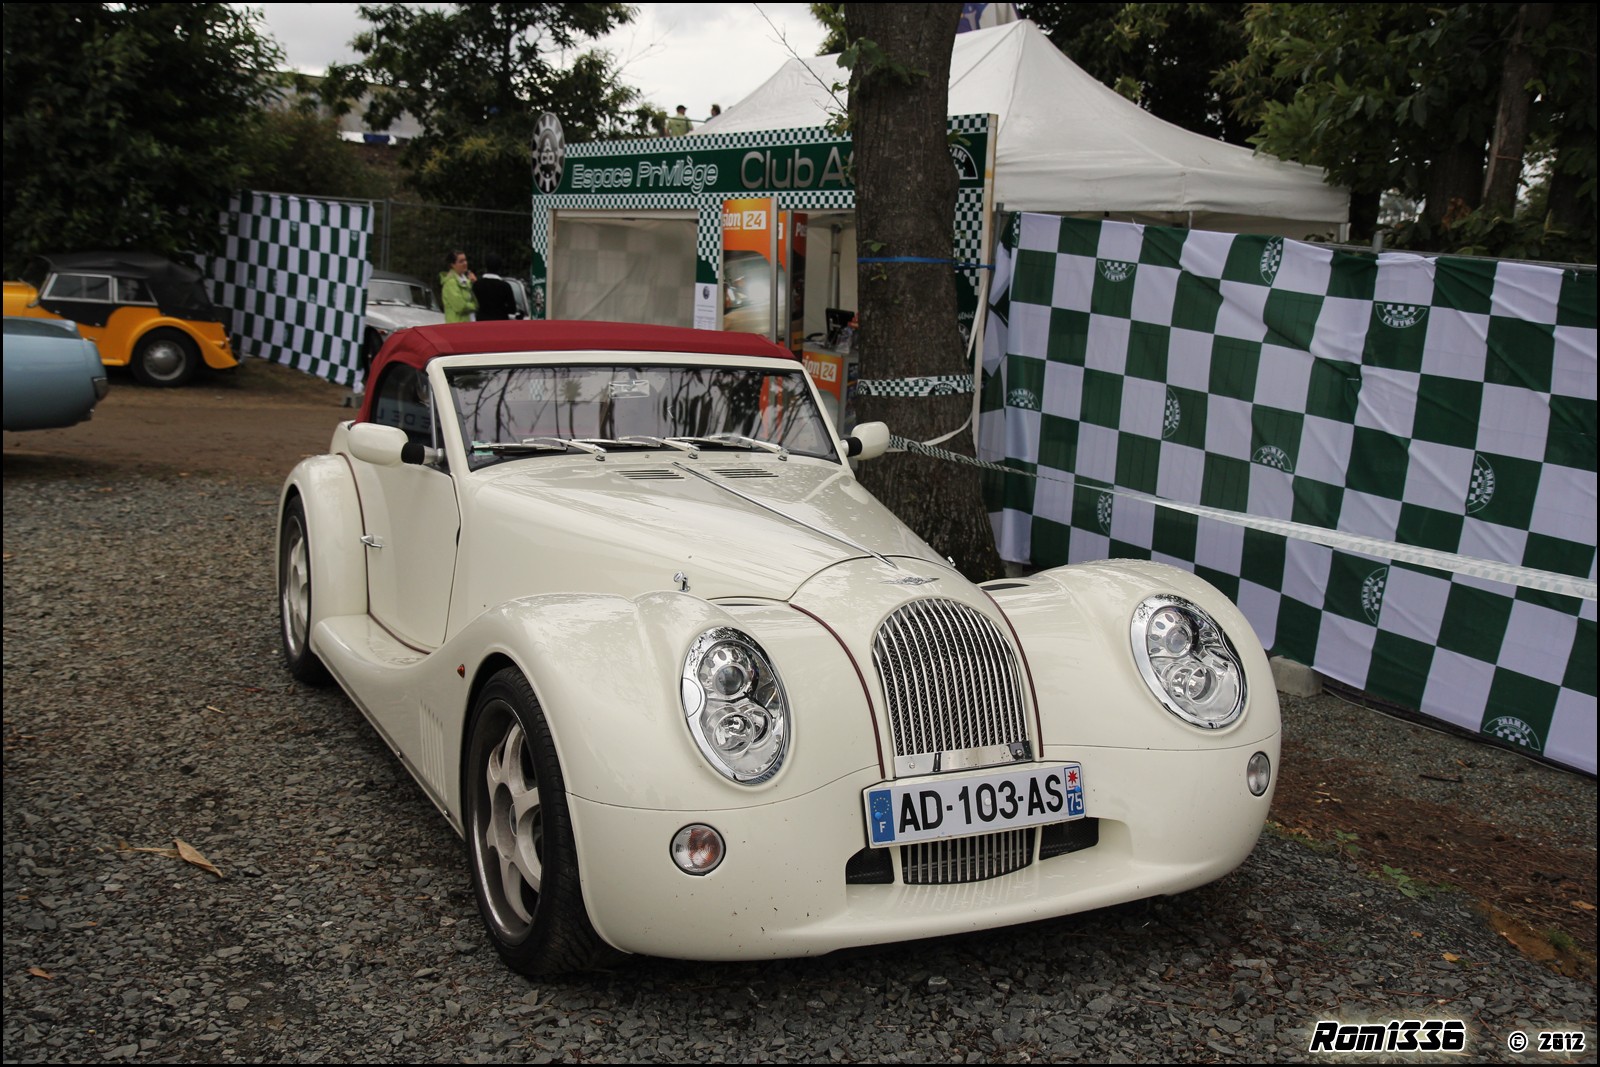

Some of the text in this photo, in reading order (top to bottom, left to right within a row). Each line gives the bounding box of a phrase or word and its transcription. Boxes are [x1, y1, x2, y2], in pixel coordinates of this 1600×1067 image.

[571, 164, 633, 193] Espace
[636, 155, 718, 194] Privilège
[740, 148, 815, 189] Club
[746, 213, 763, 227] 24
[878, 774, 1083, 833] F AD-103-AS 75
